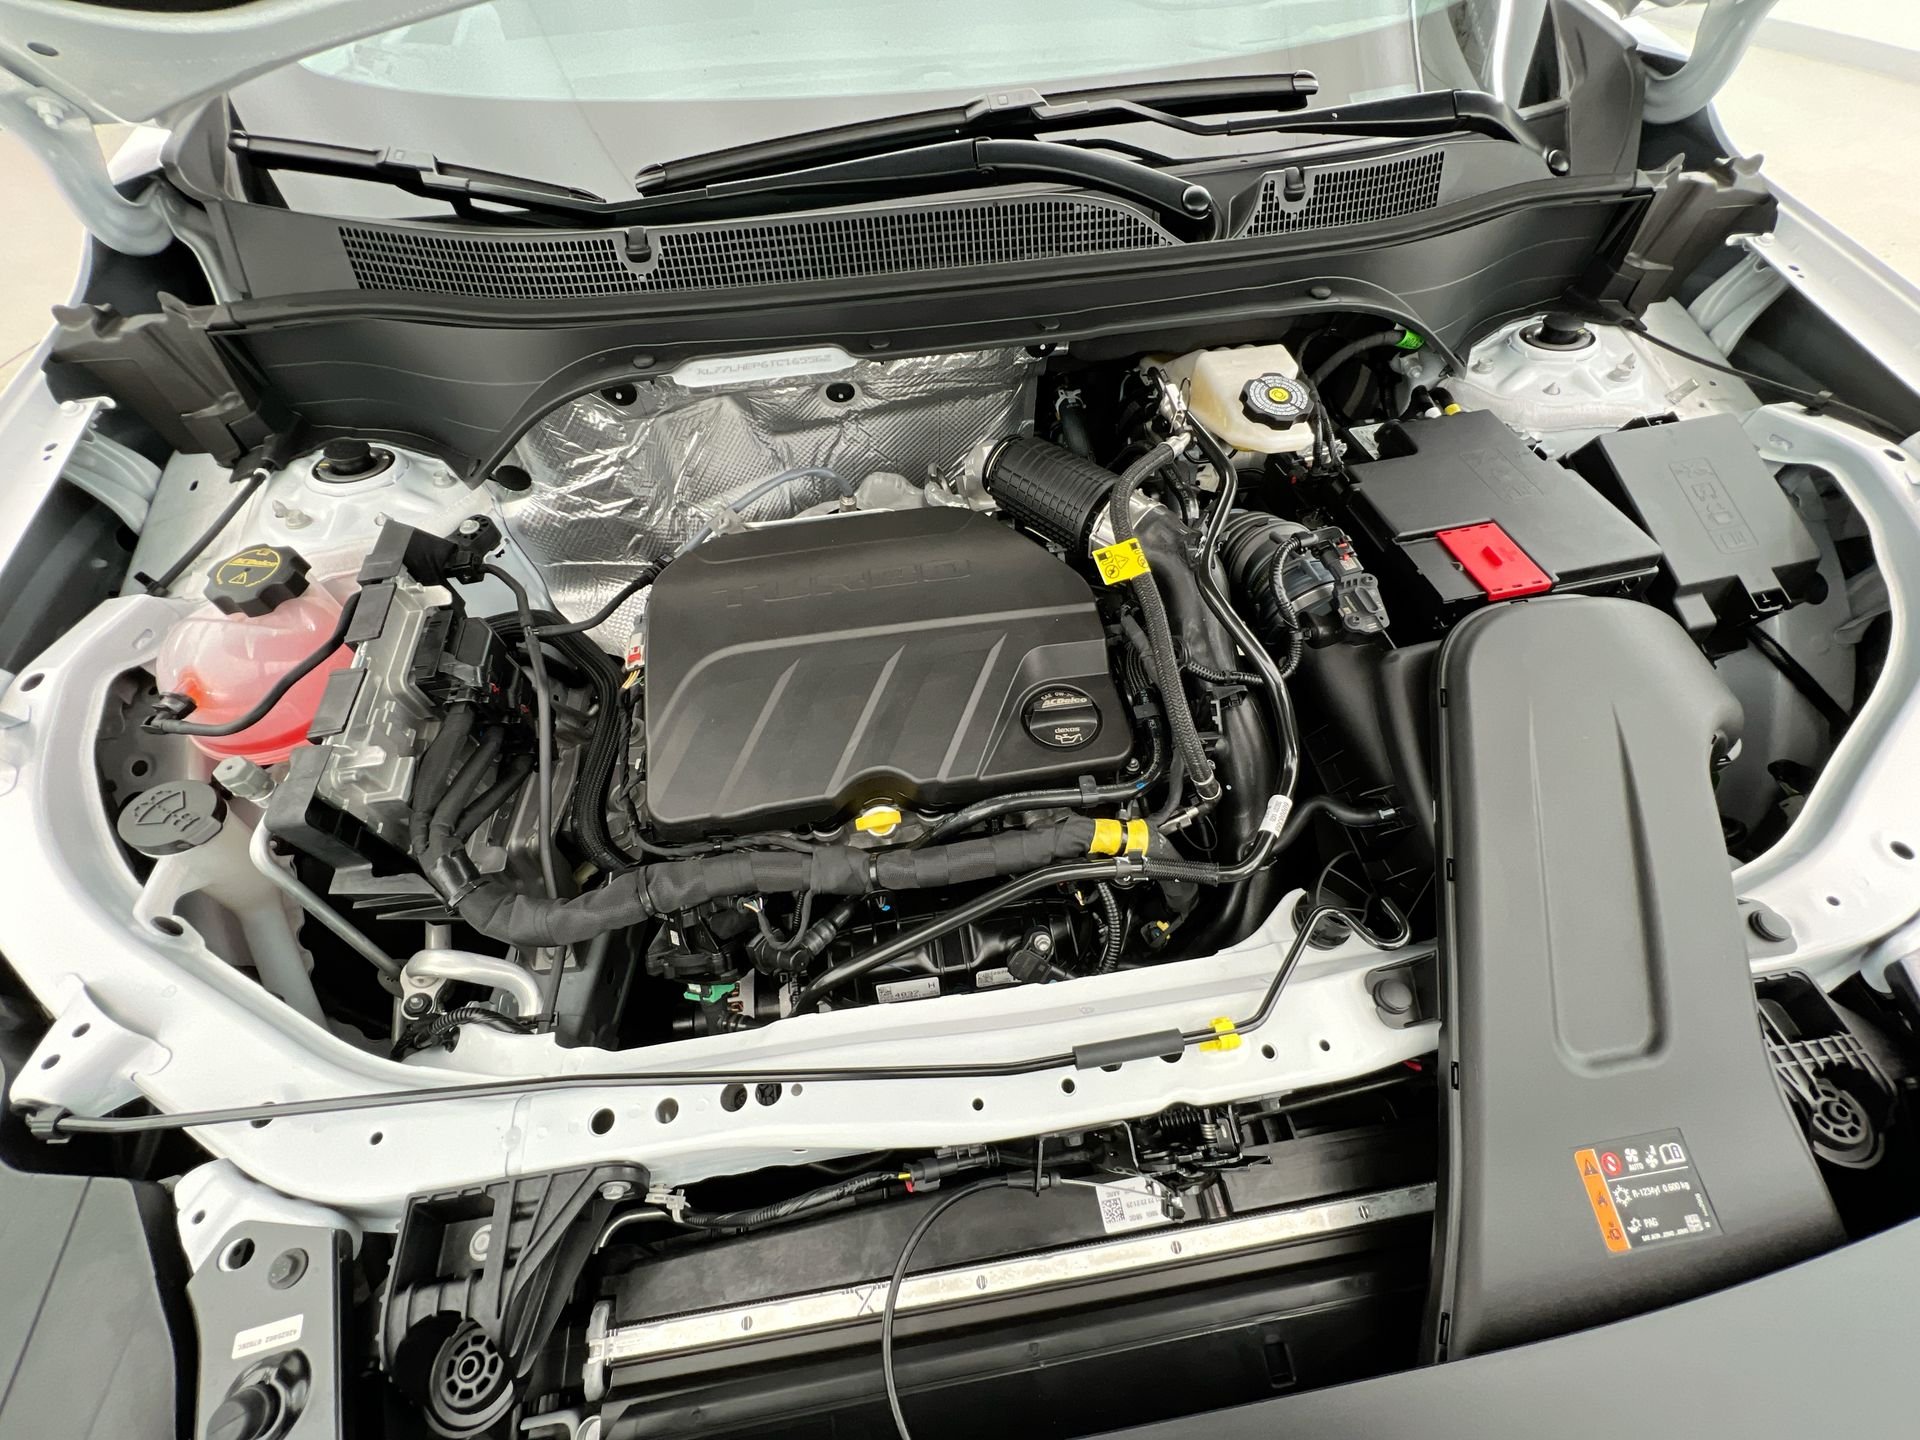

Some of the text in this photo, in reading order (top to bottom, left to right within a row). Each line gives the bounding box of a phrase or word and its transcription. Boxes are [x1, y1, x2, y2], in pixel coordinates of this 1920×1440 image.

[710, 558, 972, 608] TURBO
[1041, 697, 1088, 709] ACDelco
[1054, 726, 1081, 734] dexos
[1628, 1162, 1645, 1172] AUTO
[1643, 1217, 1660, 1229] PAG
